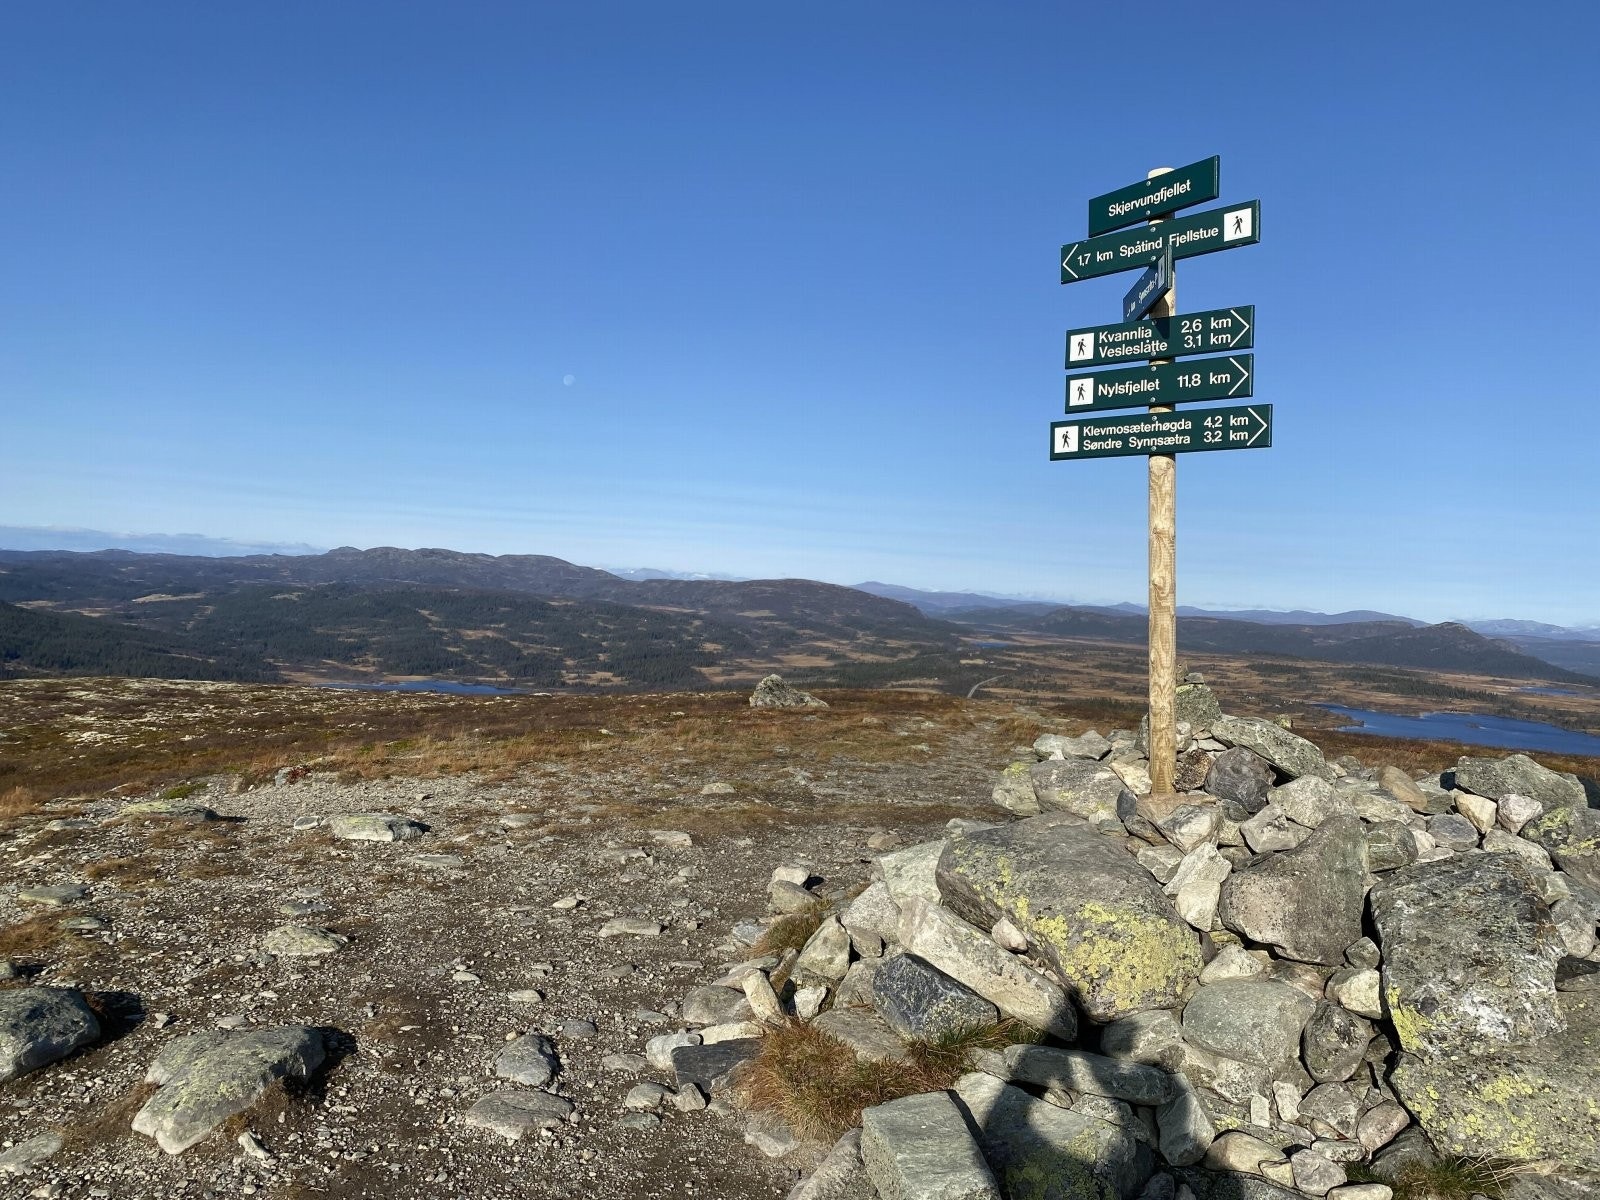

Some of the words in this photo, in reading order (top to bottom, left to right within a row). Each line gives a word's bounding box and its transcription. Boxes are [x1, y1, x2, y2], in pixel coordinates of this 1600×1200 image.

[1108, 179, 1191, 217] Skjervungfjellet
[1077, 253, 1090, 266] 1,7
[1096, 249, 1113, 262] km
[1119, 237, 1162, 259] Spåtind
[1169, 226, 1219, 247] Fjellstue
[1099, 326, 1152, 343] Kvannlia
[1181, 319, 1202, 334] 2,6
[1211, 317, 1231, 330] km
[1099, 340, 1168, 358] Vesleslåtte
[1184, 335, 1202, 349] 3,1
[1210, 333, 1231, 345] km
[1098, 378, 1160, 397] Nylsfjellet
[1177, 373, 1201, 388] 11,8
[1209, 372, 1230, 384] km
[1083, 418, 1192, 437] Klevmosæterhøgda
[1203, 415, 1223, 428] 4,2
[1230, 415, 1249, 427] km
[1083, 437, 1122, 450] Søndre
[1128, 434, 1191, 449] Synnsætra
[1203, 430, 1222, 443] 3,2
[1229, 430, 1249, 441] km
